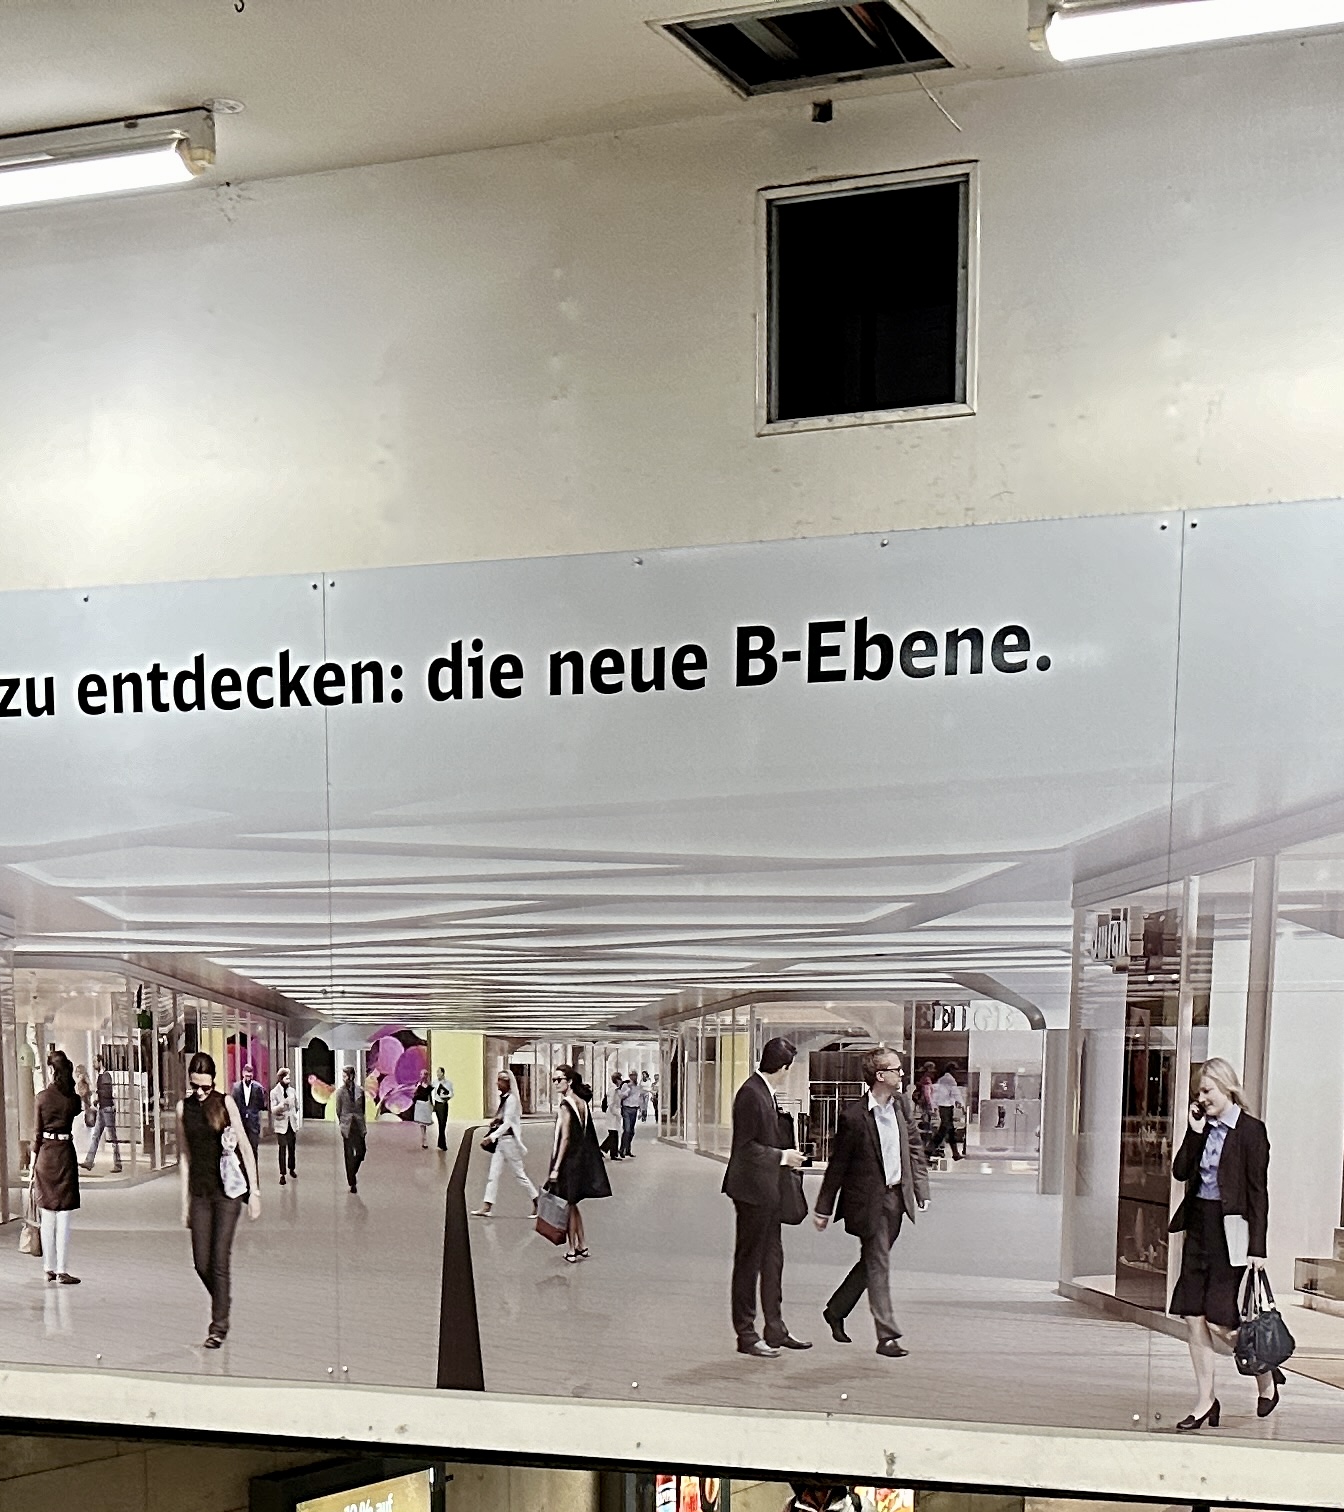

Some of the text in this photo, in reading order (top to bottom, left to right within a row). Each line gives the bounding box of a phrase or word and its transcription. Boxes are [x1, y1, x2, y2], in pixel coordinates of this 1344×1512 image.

[76, 649, 404, 716] entdecken:
[427, 638, 524, 702] die
[548, 643, 708, 696] neue
[735, 616, 1052, 687] B-Ebene.
